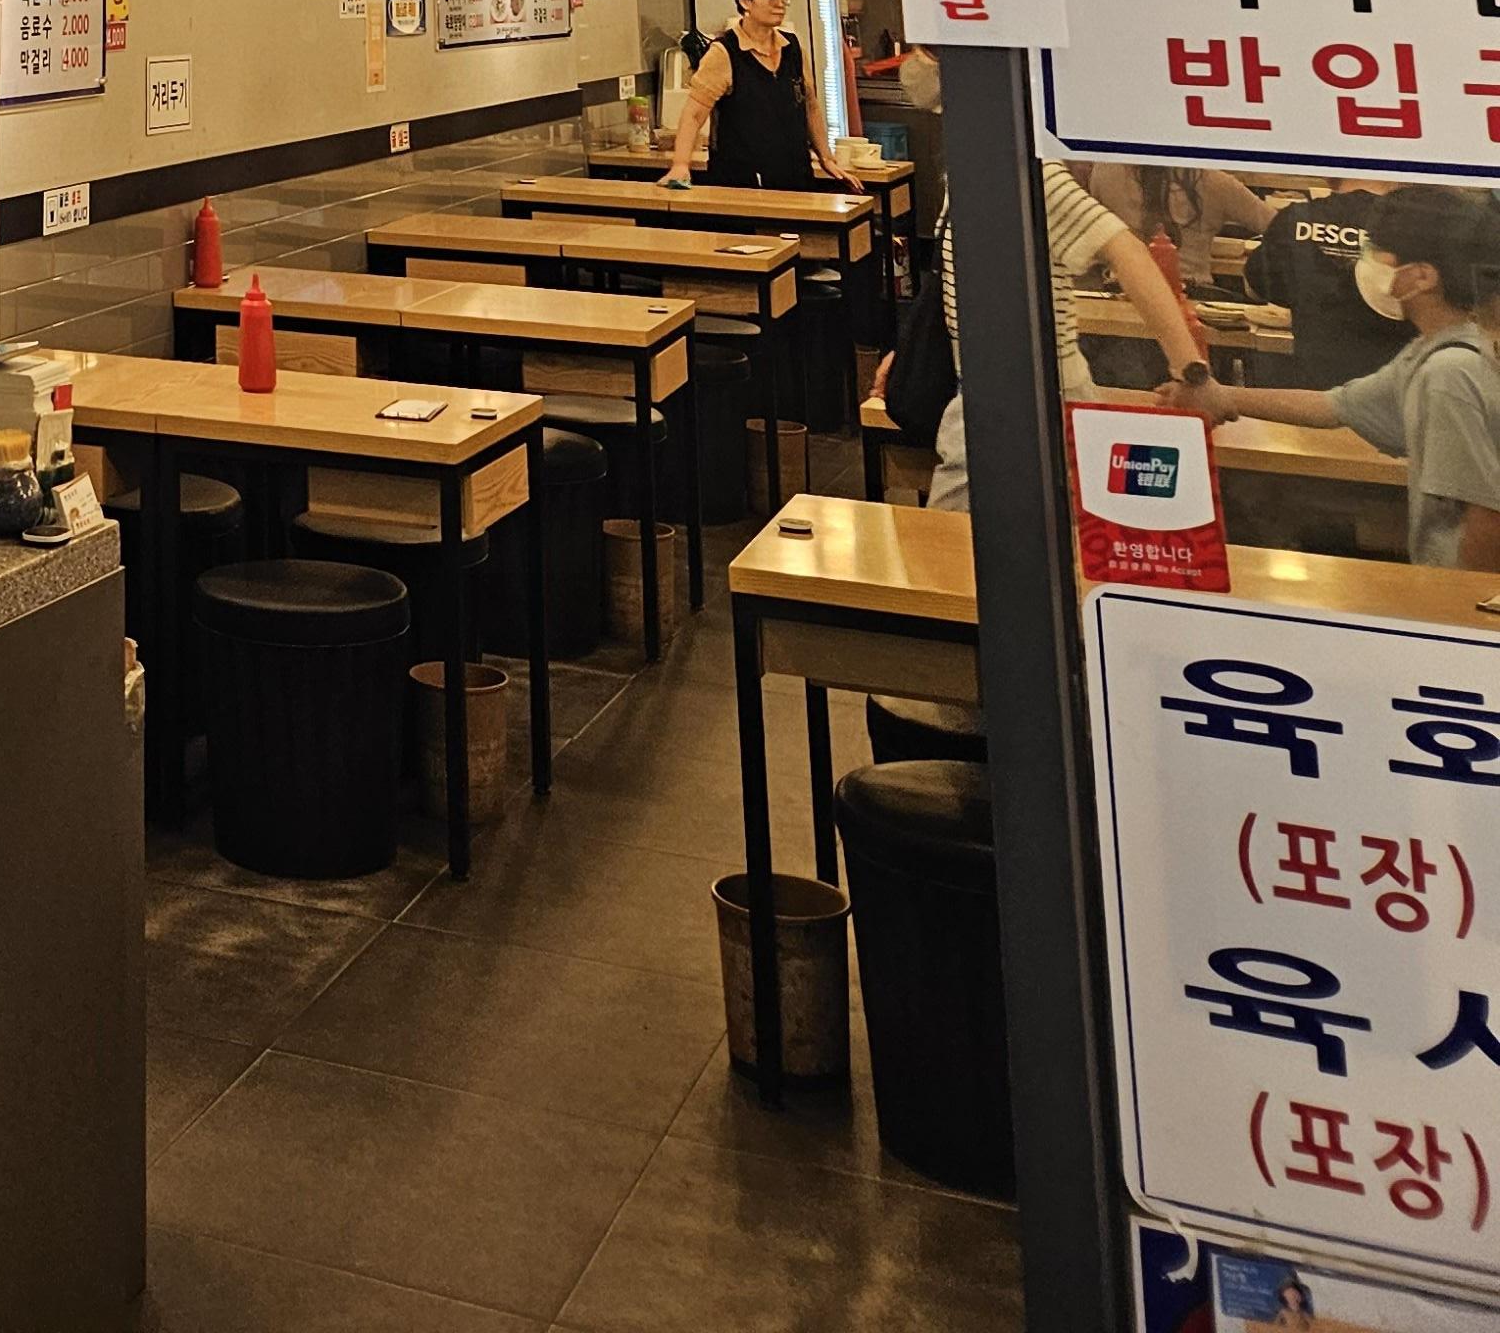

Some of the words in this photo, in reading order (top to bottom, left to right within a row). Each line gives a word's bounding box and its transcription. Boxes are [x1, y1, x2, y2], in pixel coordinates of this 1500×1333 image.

[20, 14, 53, 41] 음료수
[61, 13, 90, 36] 2.000
[20, 47, 52, 76] 막걸리
[151, 78, 188, 111] 거리두기
[1111, 454, 1177, 478] UnionPay
[1112, 540, 1194, 563] 환영합니다
[1237, 812, 1475, 940] (포장)
[1249, 1090, 1490, 1233] (포장)
